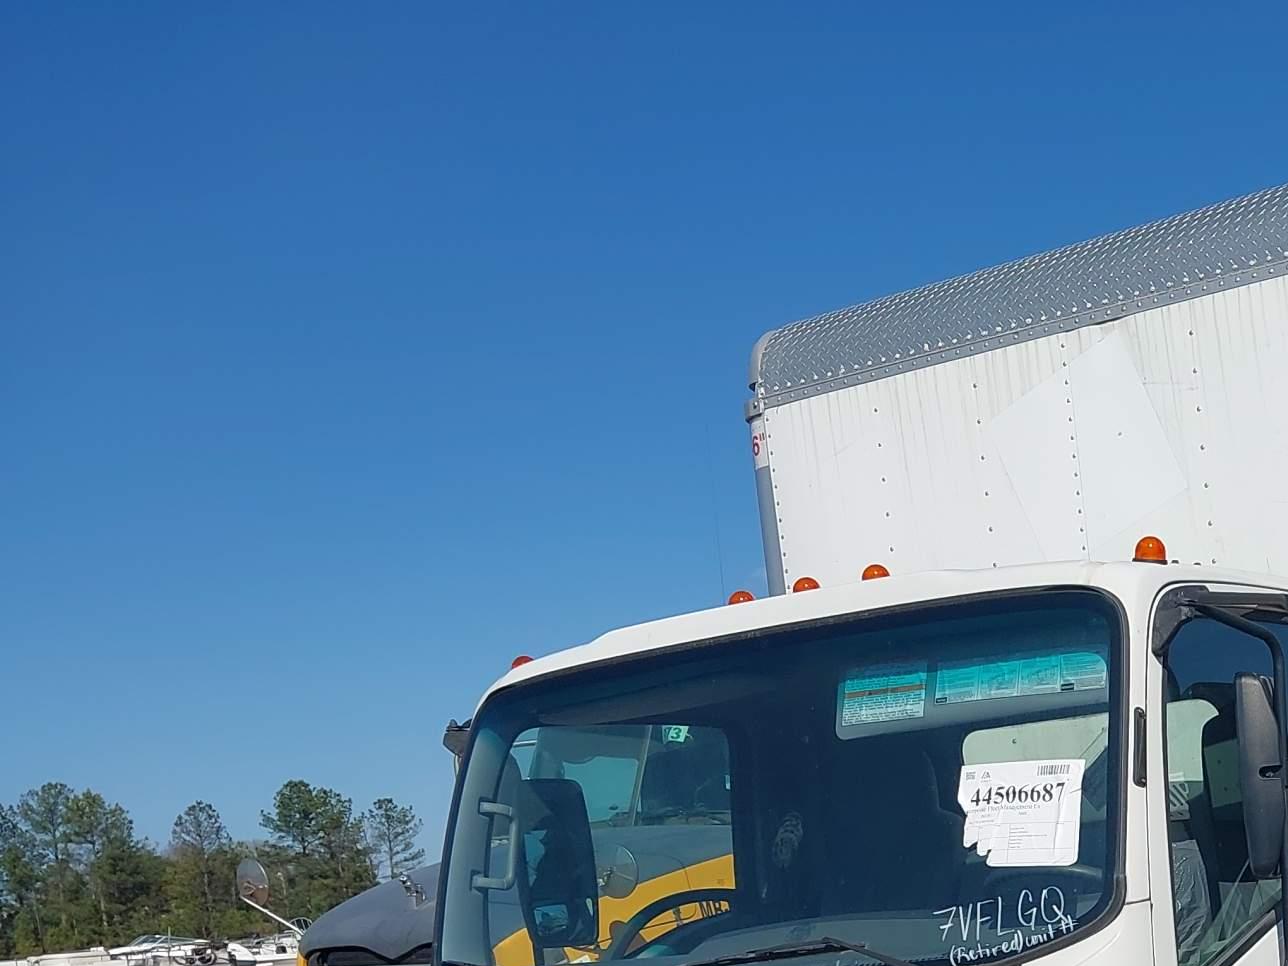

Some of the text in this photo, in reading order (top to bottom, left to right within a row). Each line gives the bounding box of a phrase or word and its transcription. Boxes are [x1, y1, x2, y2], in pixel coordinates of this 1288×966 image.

[970, 782, 1066, 806] 44506687
[950, 929, 1024, 966] (Retired)
[1025, 924, 1055, 947] unit
